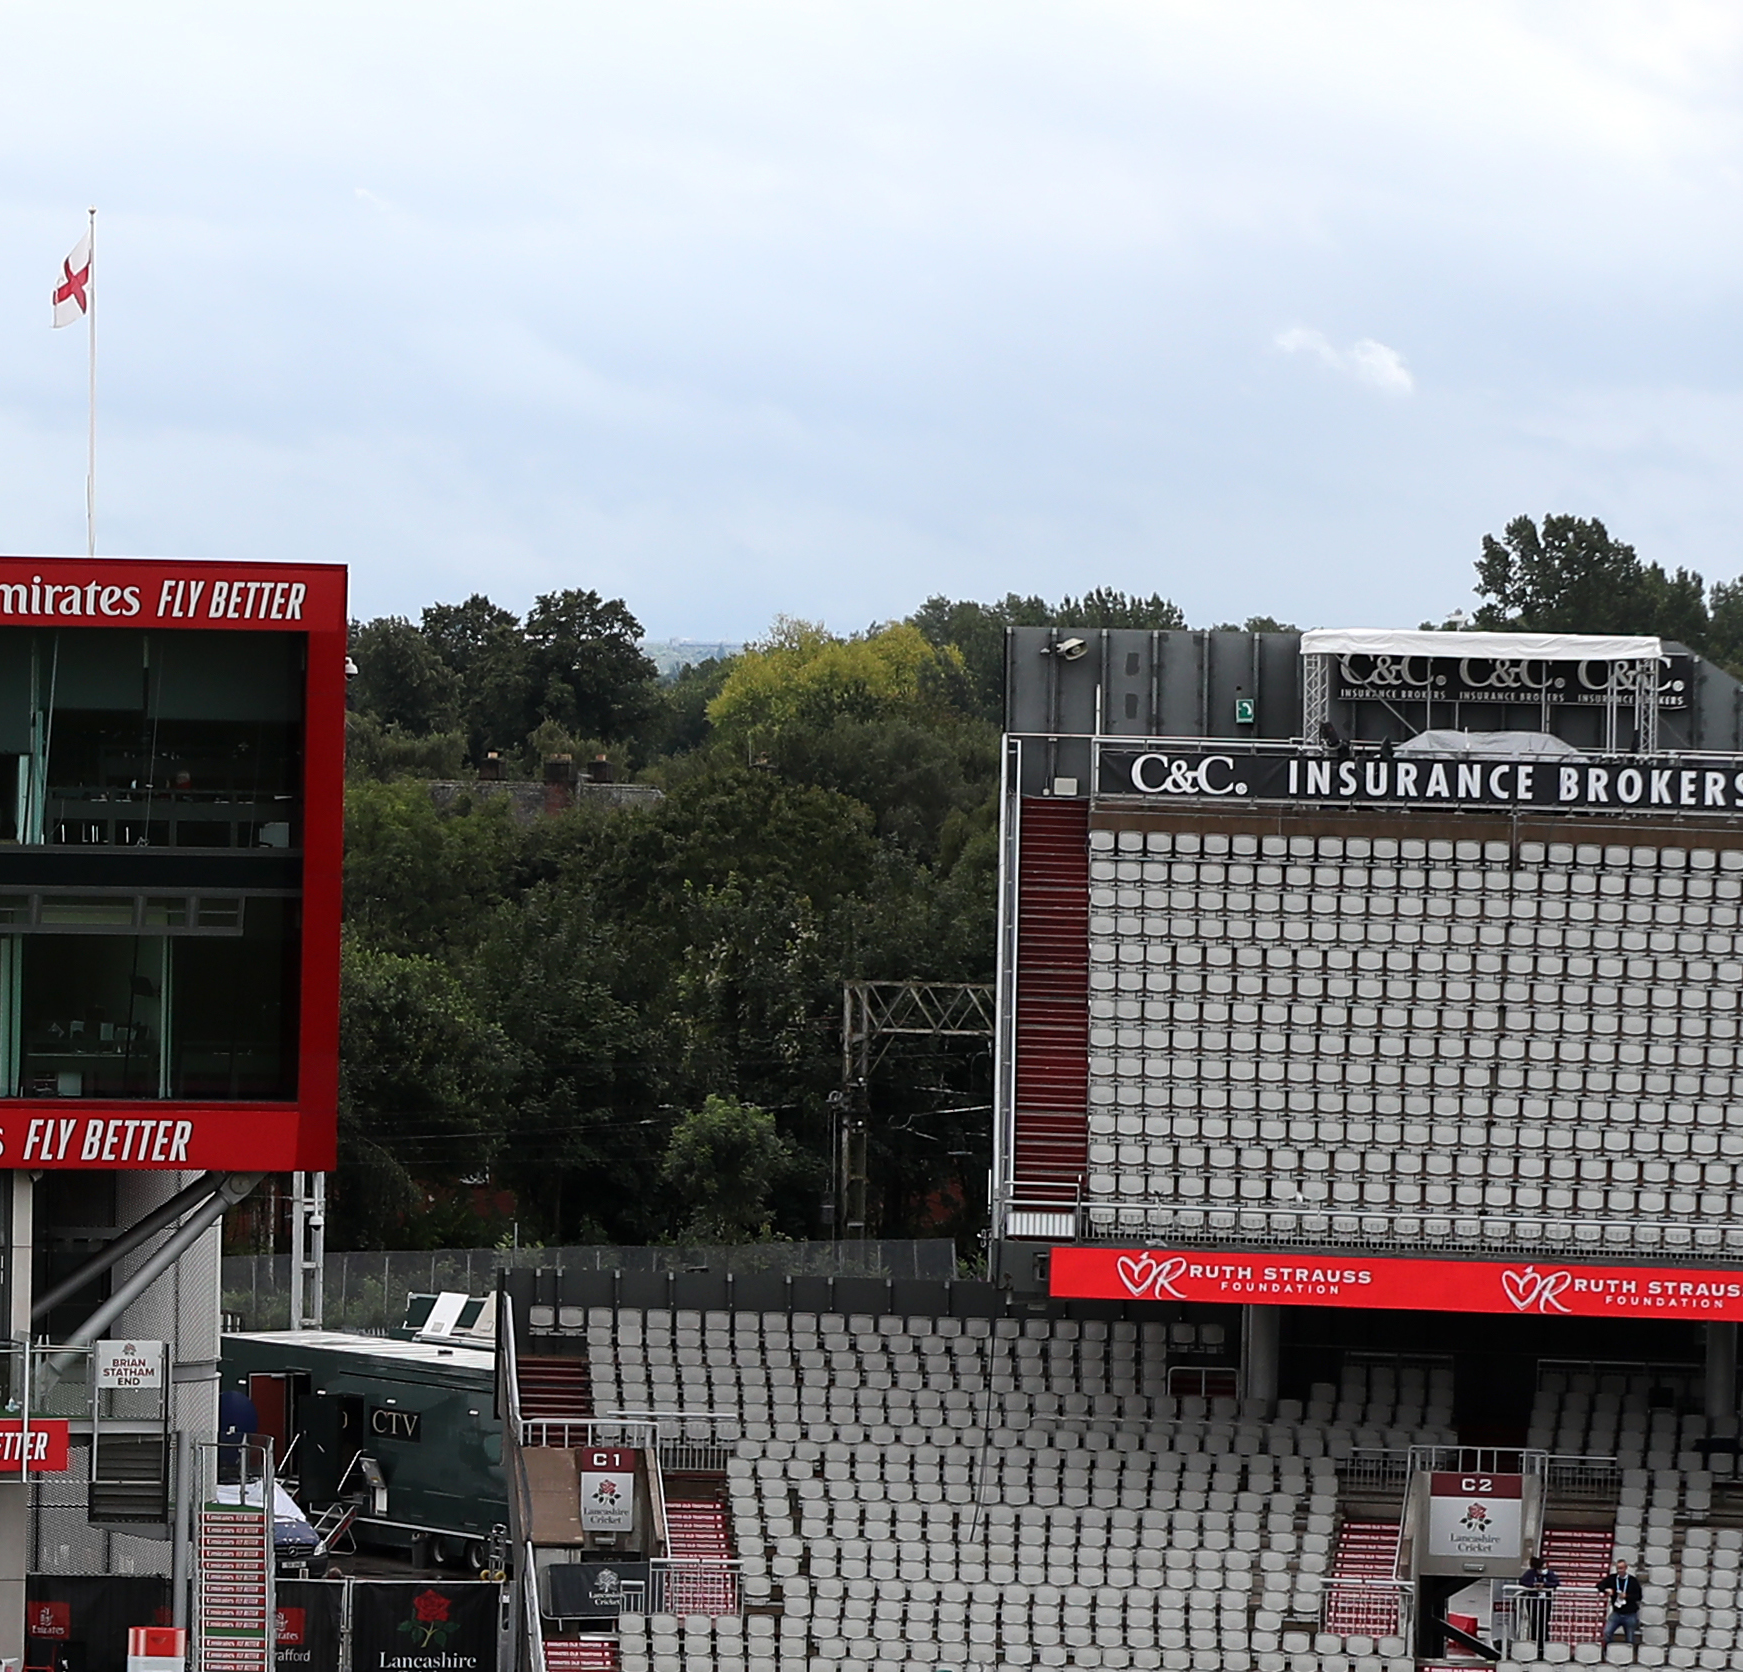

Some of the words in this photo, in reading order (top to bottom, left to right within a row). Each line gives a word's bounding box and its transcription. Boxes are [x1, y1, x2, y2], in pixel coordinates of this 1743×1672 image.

[157, 581, 204, 617] FLY
[209, 582, 305, 619] BETTER
[1340, 688, 1397, 699] INSURANCE
[1459, 691, 1514, 701] INSURANCE
[1129, 754, 1247, 796] C&C.
[1288, 758, 1534, 802] INSURANCE
[23, 1119, 76, 1160] FLY
[81, 1120, 191, 1161] BETTER
[1190, 1265, 1251, 1279] RUTH
[1263, 1267, 1372, 1286] STRAUSS
[1222, 1282, 1338, 1294] FOUNDATION
[1575, 1279, 1636, 1293] RUTH
[1649, 1282, 1740, 1297] STRAUS
[1606, 1296, 1722, 1308] FOUNDATION
[112, 1358, 146, 1367] BRIAN
[102, 1367, 155, 1377] STATHAM
[117, 1377, 141, 1386] END
[371, 1409, 420, 1437] CTV
[583, 1507, 630, 1517] Lancashire
[590, 1515, 622, 1525] Cricket
[1449, 1533, 1501, 1544] Lancashire
[1457, 1542, 1492, 1552] Cricket
[31, 1625, 65, 1635] Emirates
[380, 1652, 476, 1668] Lancashire
